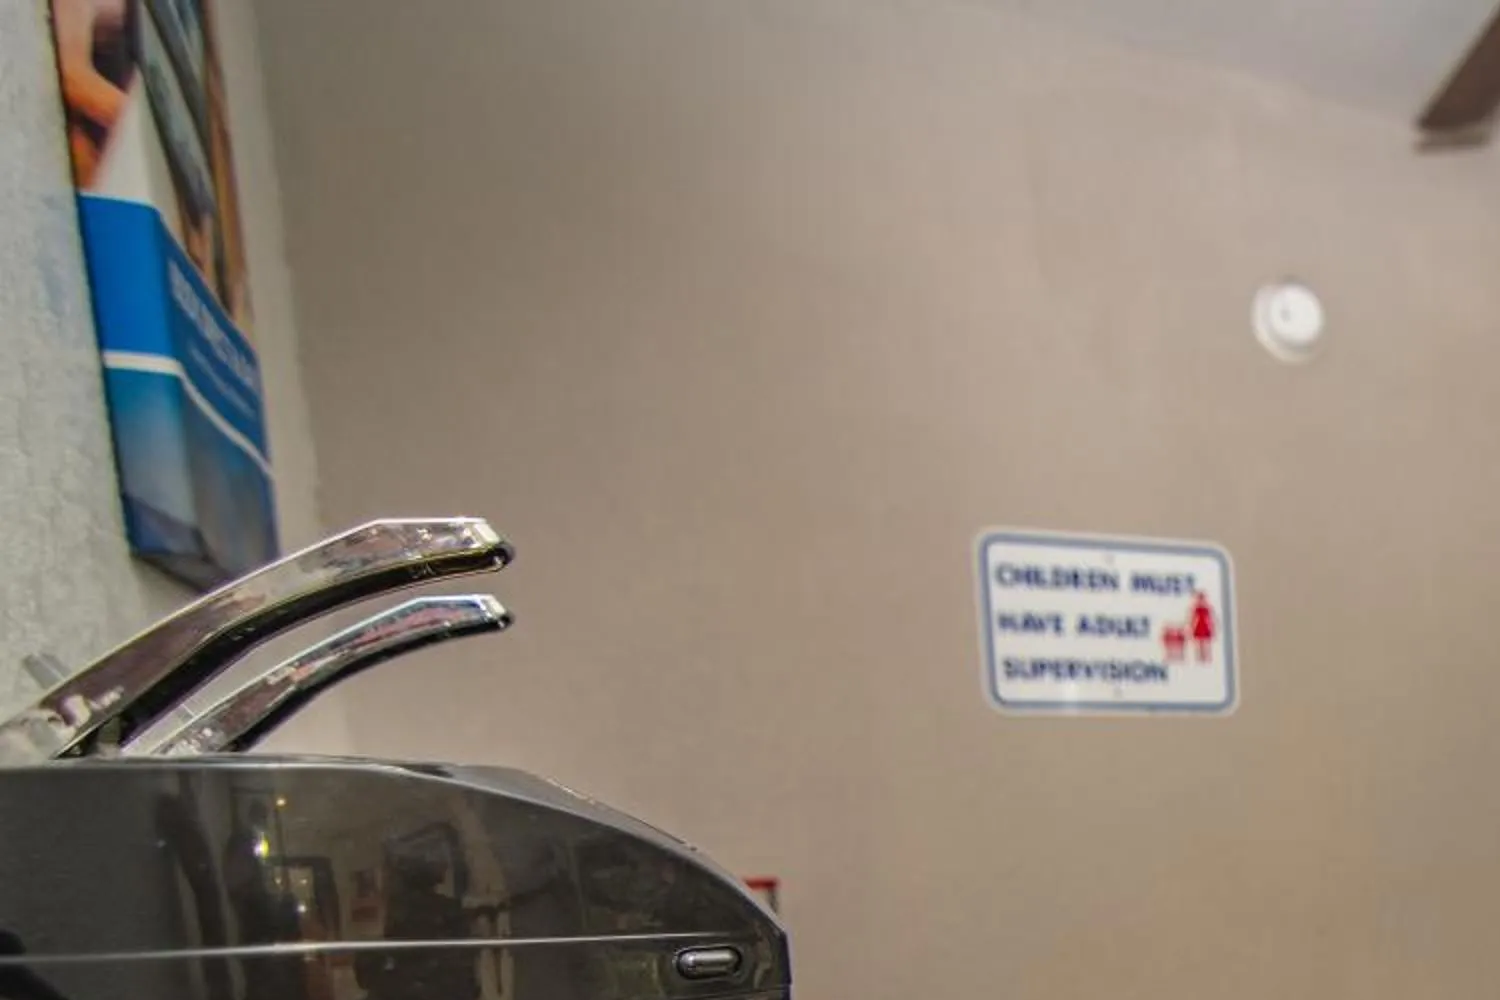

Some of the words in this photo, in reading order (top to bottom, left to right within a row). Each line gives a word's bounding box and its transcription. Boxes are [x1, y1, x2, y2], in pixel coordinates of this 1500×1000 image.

[996, 562, 1118, 590] CHILDREN
[1131, 571, 1196, 595] MUST
[998, 612, 1063, 635] HAVE
[1077, 614, 1150, 638] ADULT
[1004, 656, 1168, 681] SUPERVISION
